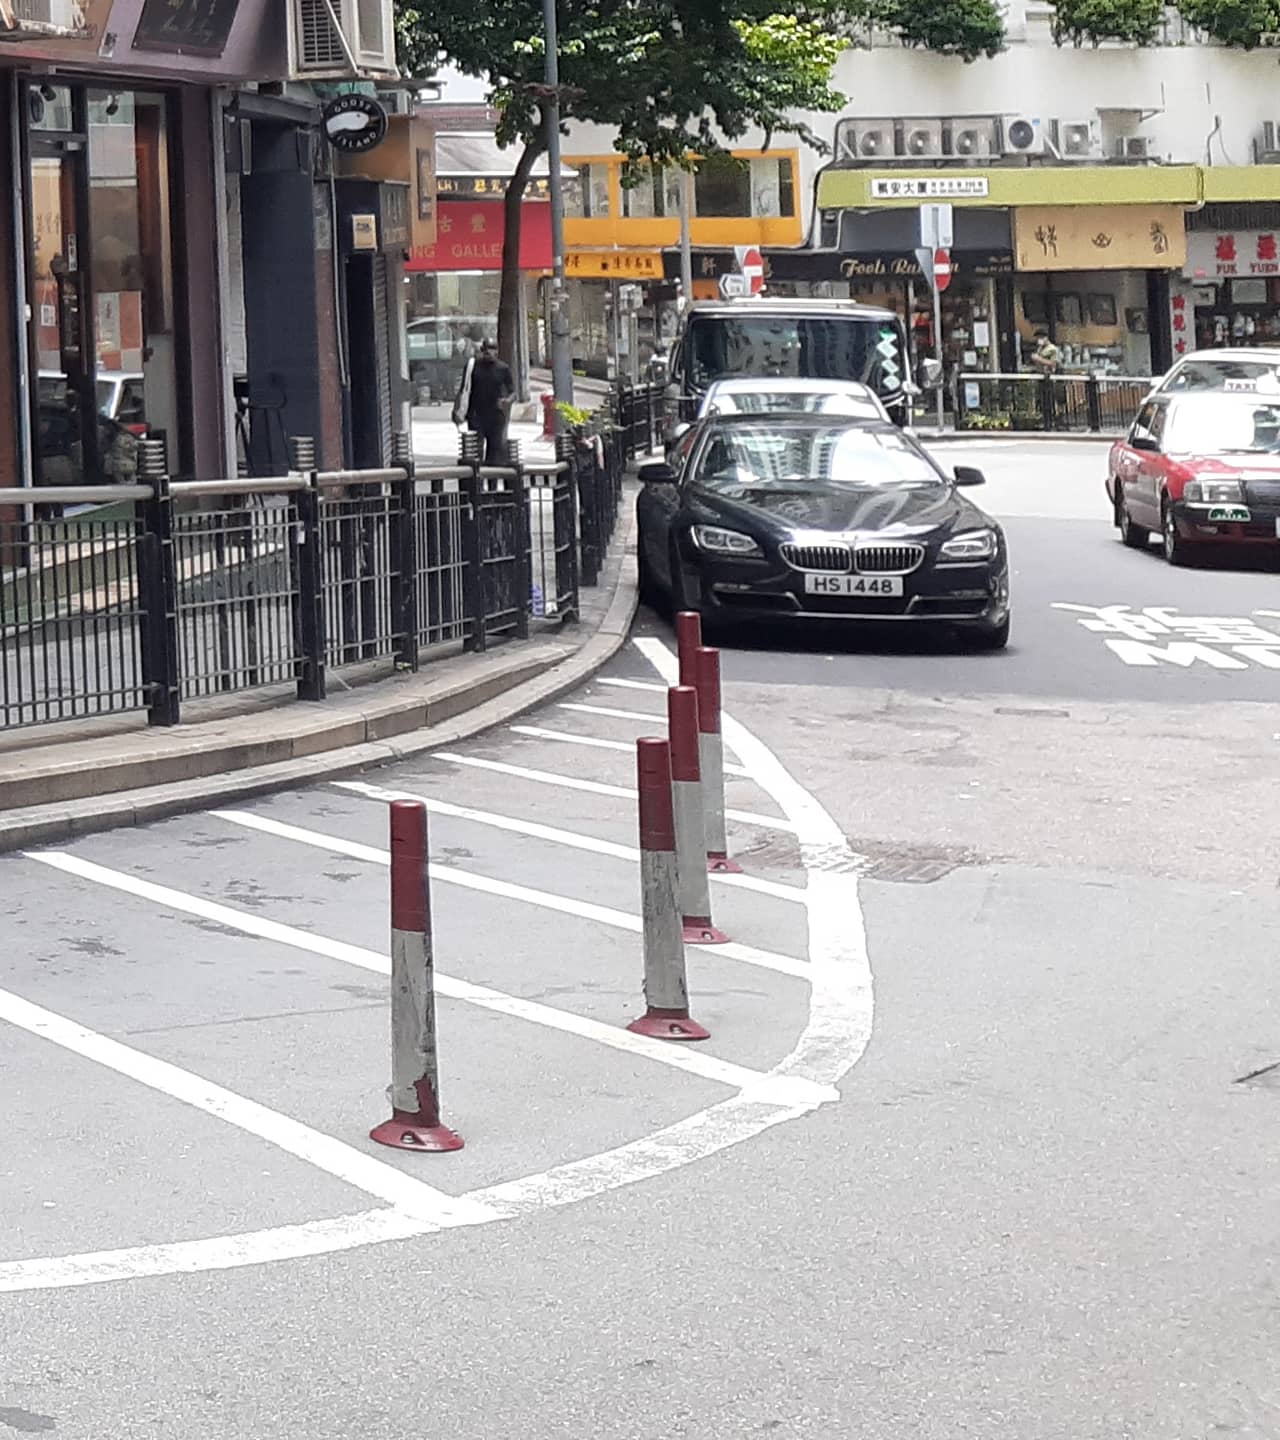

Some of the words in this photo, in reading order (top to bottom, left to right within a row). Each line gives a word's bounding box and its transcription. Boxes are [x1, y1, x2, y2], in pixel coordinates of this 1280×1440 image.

[334, 97, 372, 113] GOOSE
[451, 243, 503, 258] GALLE
[1216, 263, 1238, 274] FUK
[814, 577, 841, 592] HS
[847, 578, 893, 594] 1448
